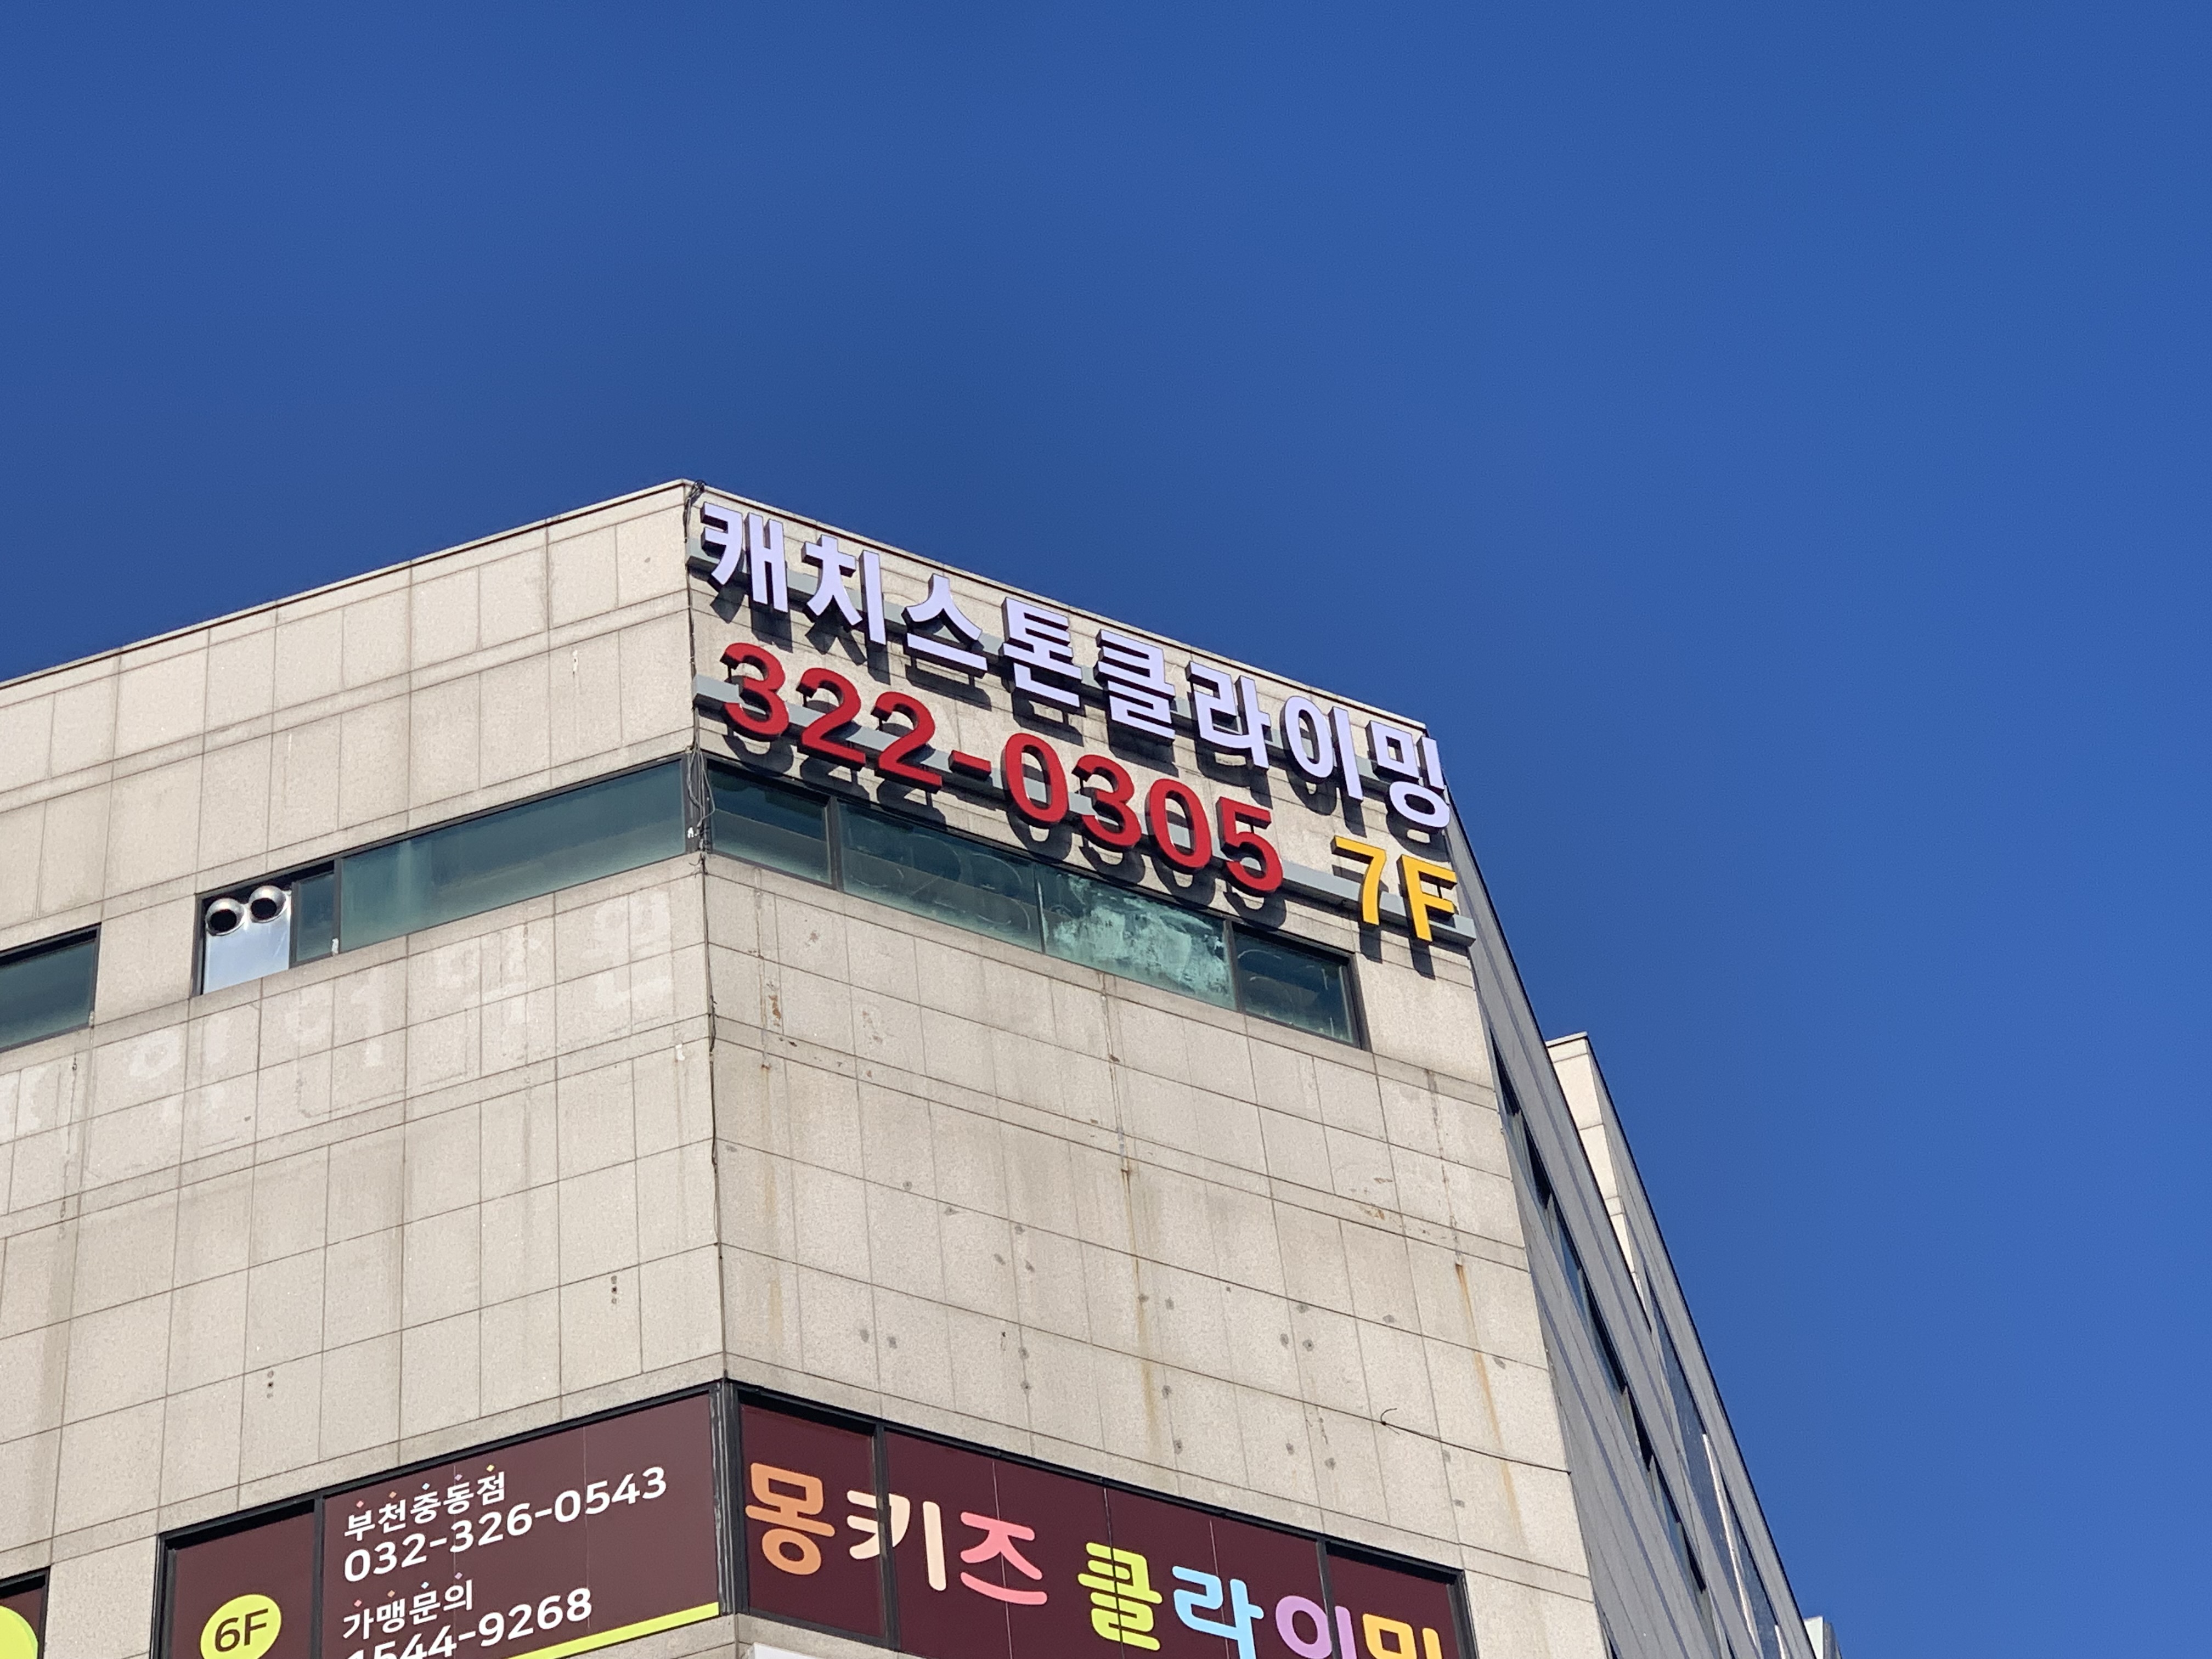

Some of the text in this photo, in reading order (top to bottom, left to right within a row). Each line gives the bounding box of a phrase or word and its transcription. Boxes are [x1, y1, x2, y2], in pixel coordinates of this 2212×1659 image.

[701, 501, 1451, 829] 캐치스톤클라이밍
[721, 642, 1458, 943] 322-0305 7F
[343, 1471, 505, 1541] 부천중동점
[343, 1466, 667, 1582] 032-326-0543
[745, 1462, 1048, 1605] 몽키즈
[214, 1607, 269, 1652] 6F
[342, 1579, 473, 1640] 가맹문의
[347, 1587, 592, 1659] 544-9268
